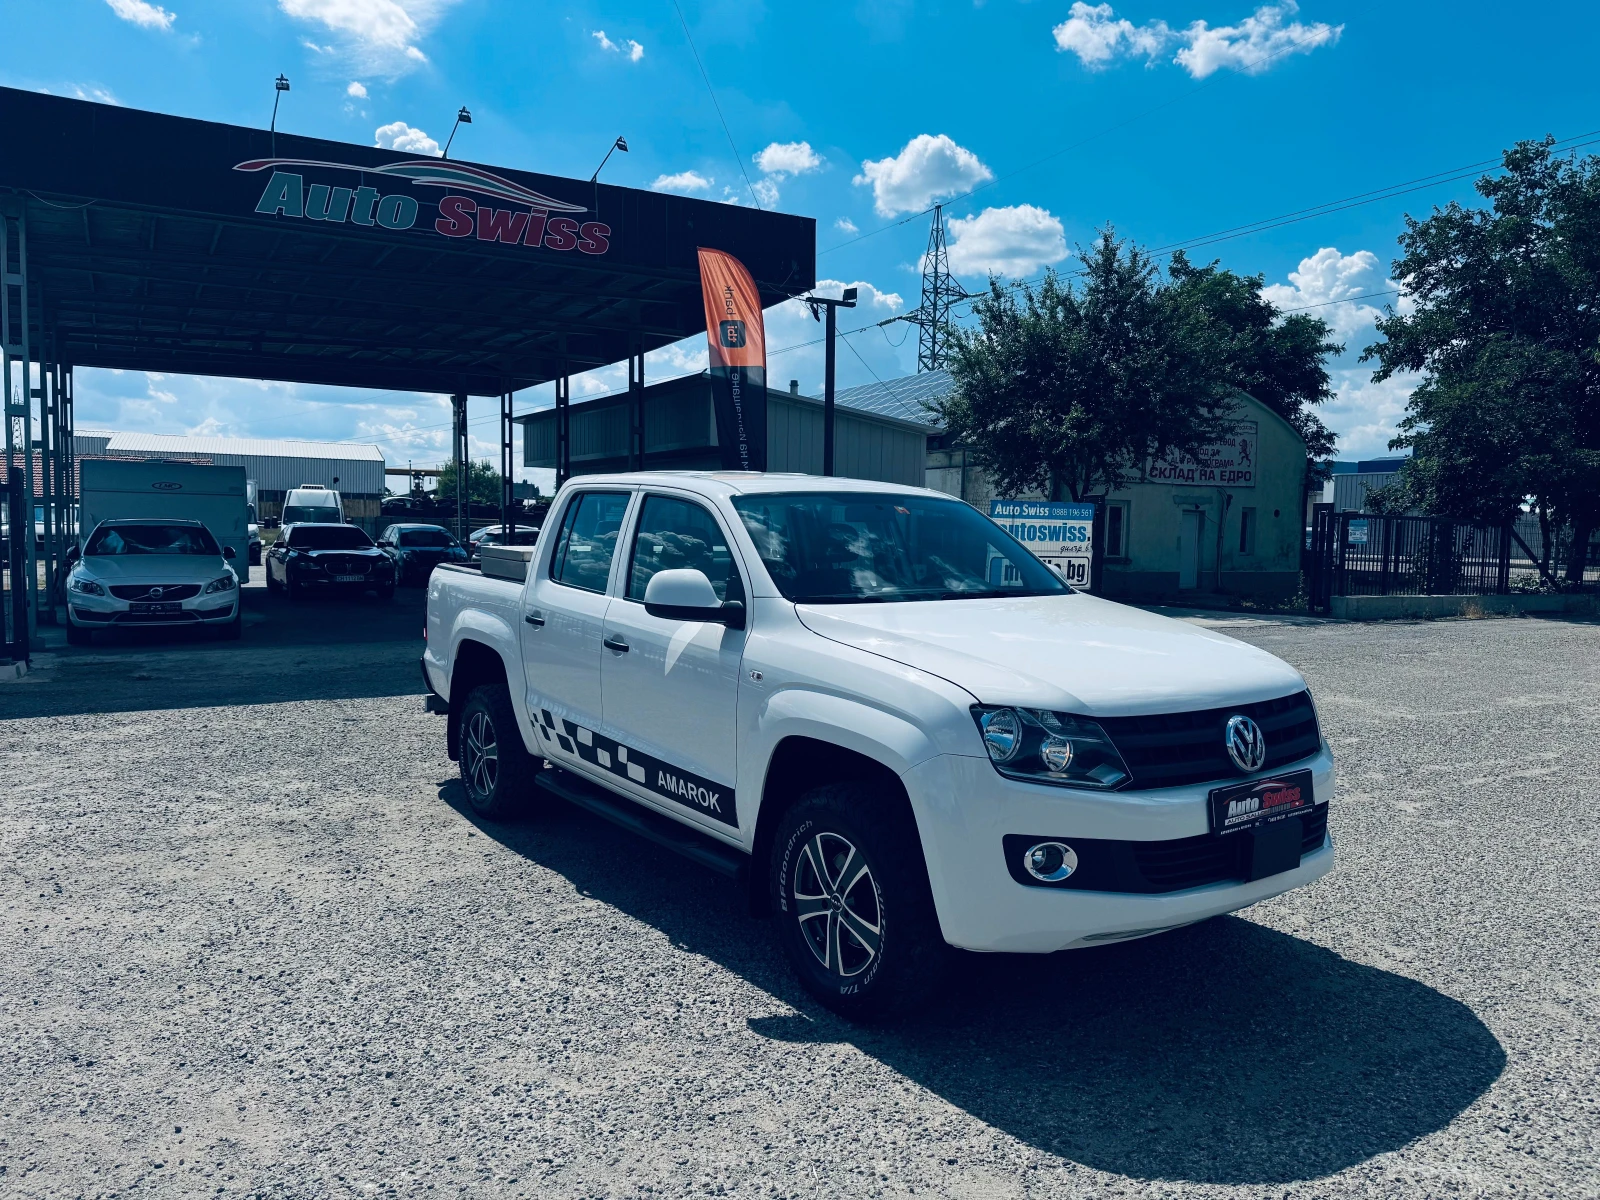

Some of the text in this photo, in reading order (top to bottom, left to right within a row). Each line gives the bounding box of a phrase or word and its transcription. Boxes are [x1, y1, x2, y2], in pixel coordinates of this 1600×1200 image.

[254, 171, 611, 254] Auto Swiss
[1150, 467, 1252, 484] СКЛАД НА ЕДРО
[994, 503, 1020, 516] Auto
[1022, 504, 1049, 516] Swiss
[1051, 508, 1068, 516] 0888
[1081, 509, 1092, 517] 561
[657, 770, 721, 814] AMAROK
[1227, 797, 1259, 818] Auto
[1262, 786, 1301, 809] Swiss
[779, 819, 813, 912] BFGoodrich
